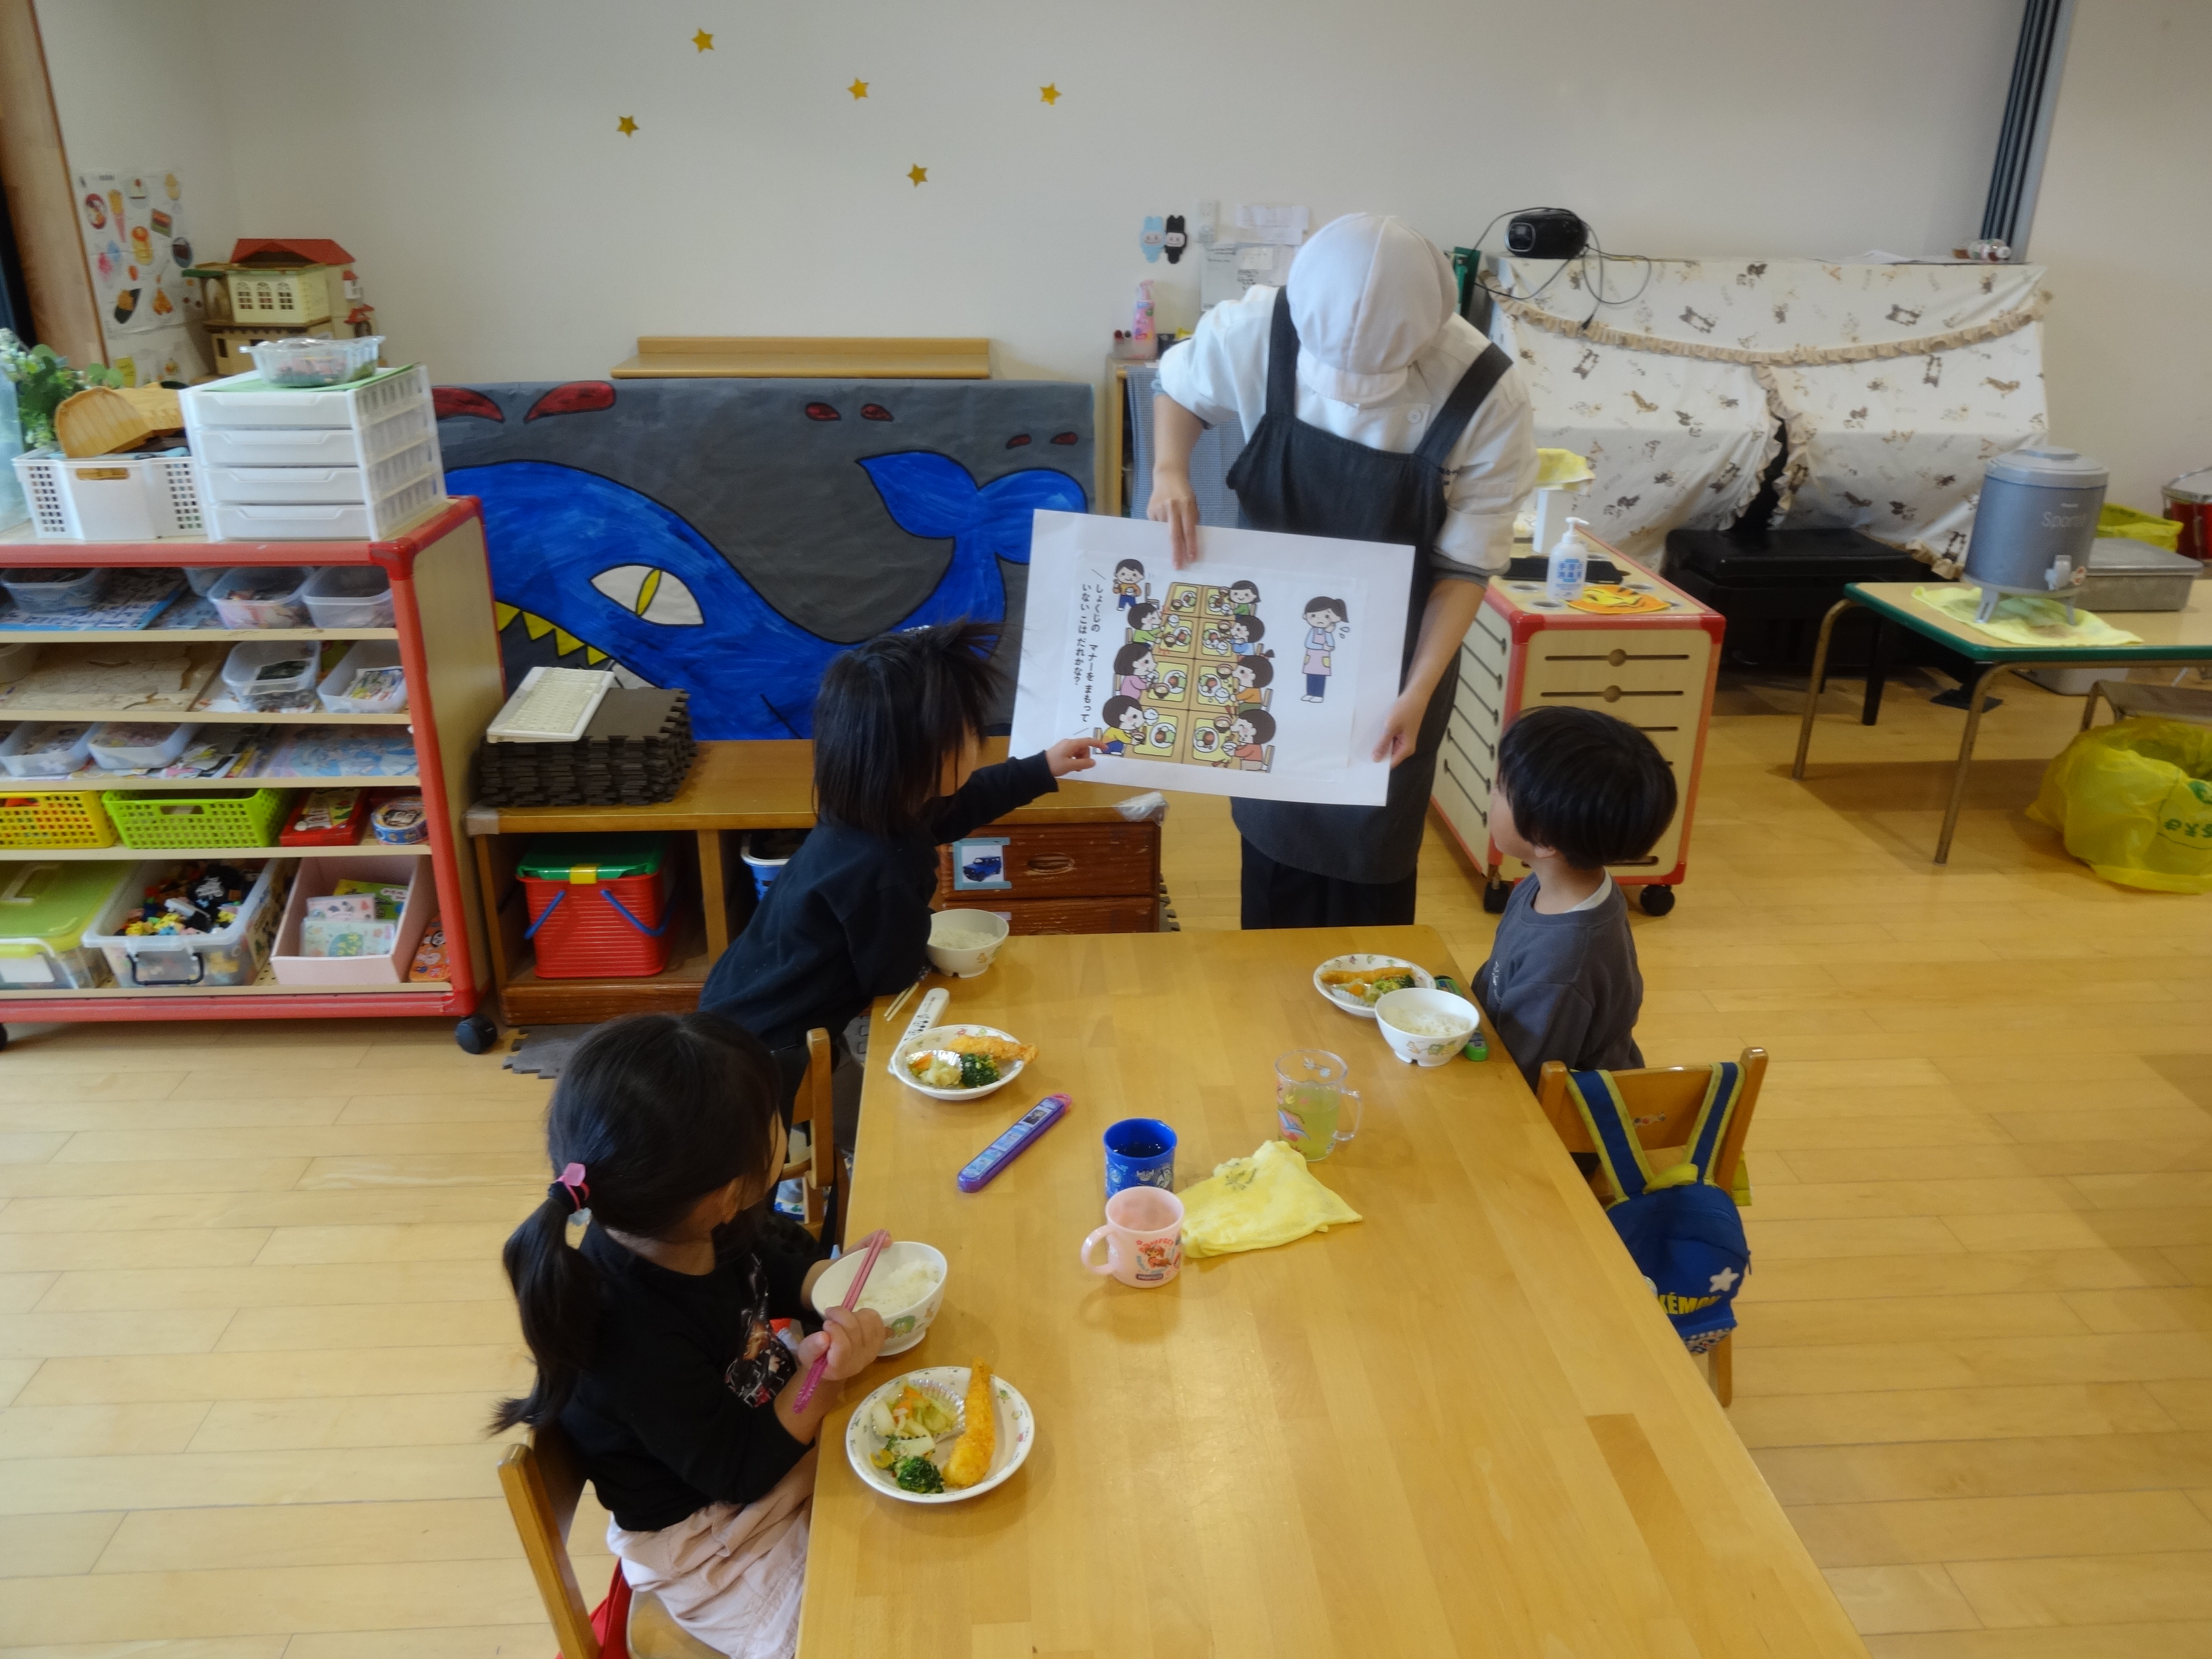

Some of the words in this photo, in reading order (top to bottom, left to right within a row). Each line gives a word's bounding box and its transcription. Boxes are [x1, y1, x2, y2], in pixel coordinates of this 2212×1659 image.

[1081, 583, 1092, 611] いない
[1091, 583, 1104, 632] しょくじの
[1078, 616, 1088, 634] こは
[1086, 644, 1099, 682] マナーを
[1081, 684, 1093, 723] まもって
